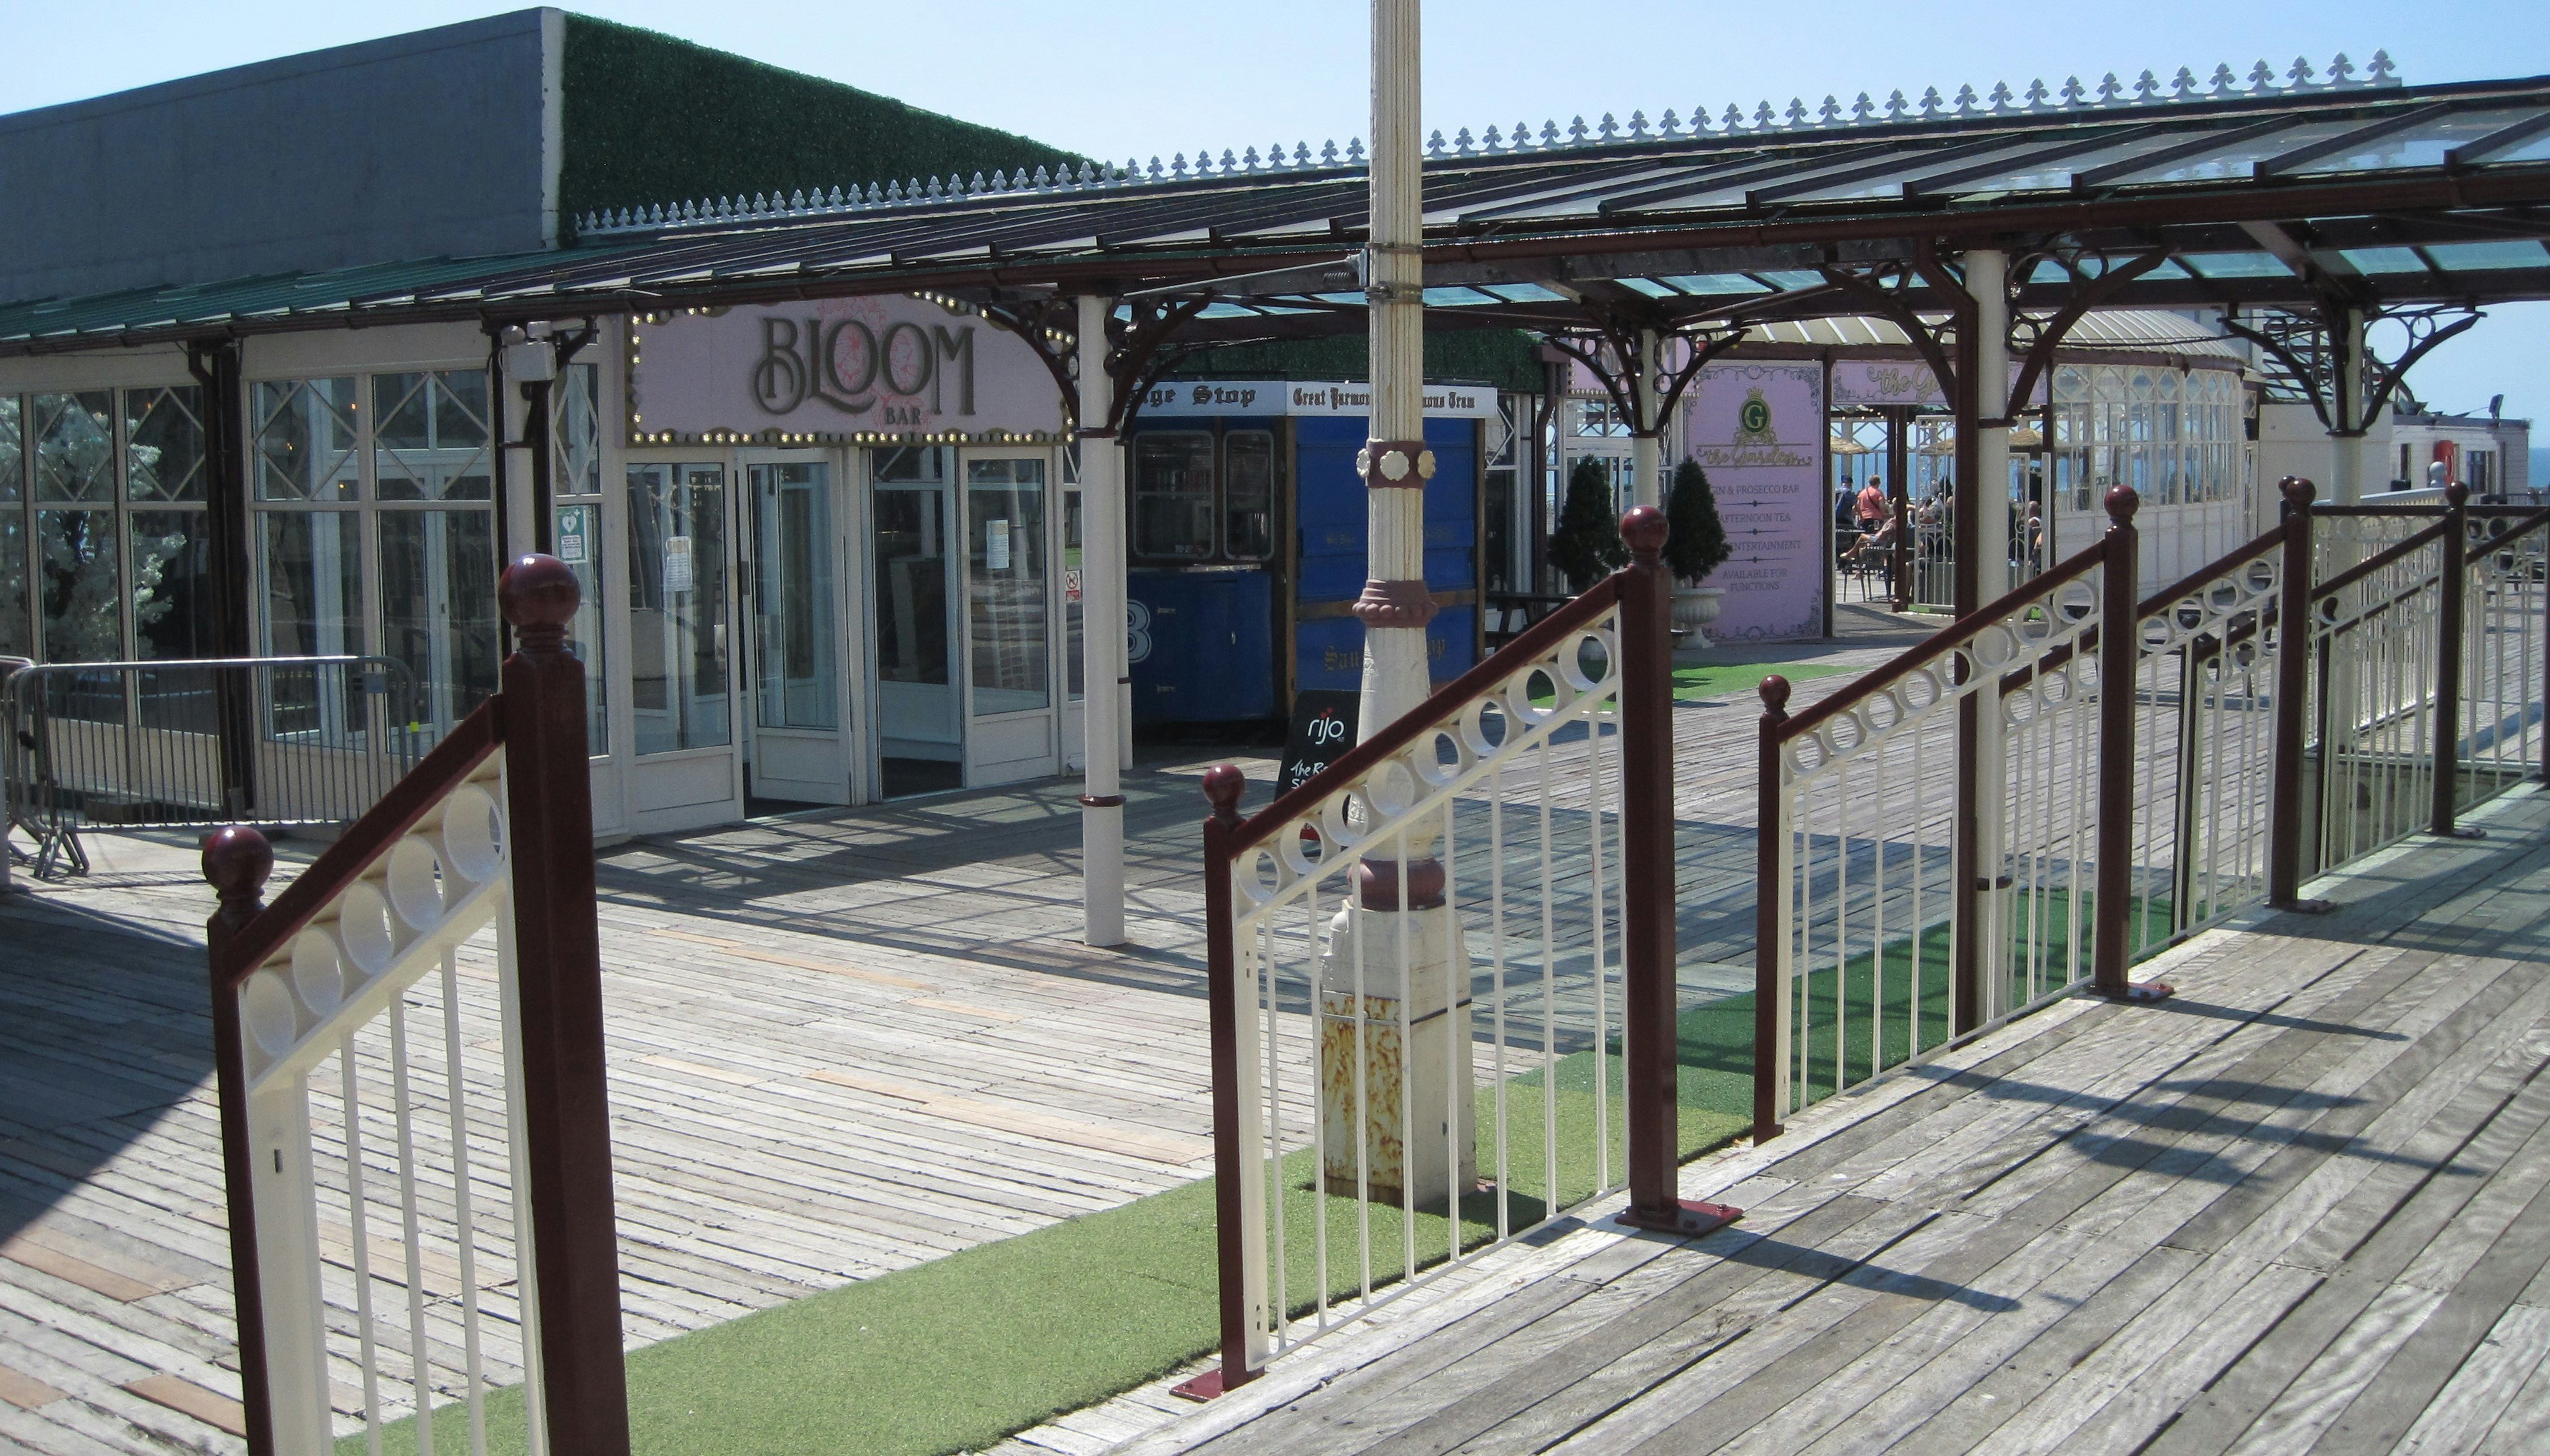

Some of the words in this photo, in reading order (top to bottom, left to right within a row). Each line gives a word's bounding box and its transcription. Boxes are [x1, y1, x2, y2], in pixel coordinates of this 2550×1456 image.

[754, 317, 976, 415] BLOOM
[1867, 365, 1911, 396] the
[1912, 362, 1940, 404] Ga
[1192, 385, 1257, 408] Stop
[1293, 387, 1326, 406] Great
[1448, 391, 1476, 409] Tram
[885, 407, 921, 425] BAR
[1744, 404, 1765, 429] G
[1696, 448, 1730, 465] the
[1731, 443, 1813, 470] Garden
[1728, 485, 1735, 495] &
[1736, 485, 1780, 495] PROSECCO
[1783, 484, 1799, 494] BAR
[1720, 513, 1773, 524] AFTERNOON
[1775, 512, 1791, 522] TEA
[1723, 569, 1768, 580] AVAILABLE
[1770, 568, 1788, 577] FOR
[1730, 581, 1780, 592] FUNCTIONS
[1307, 716, 1345, 745] rijo
[1290, 759, 1311, 777] The
